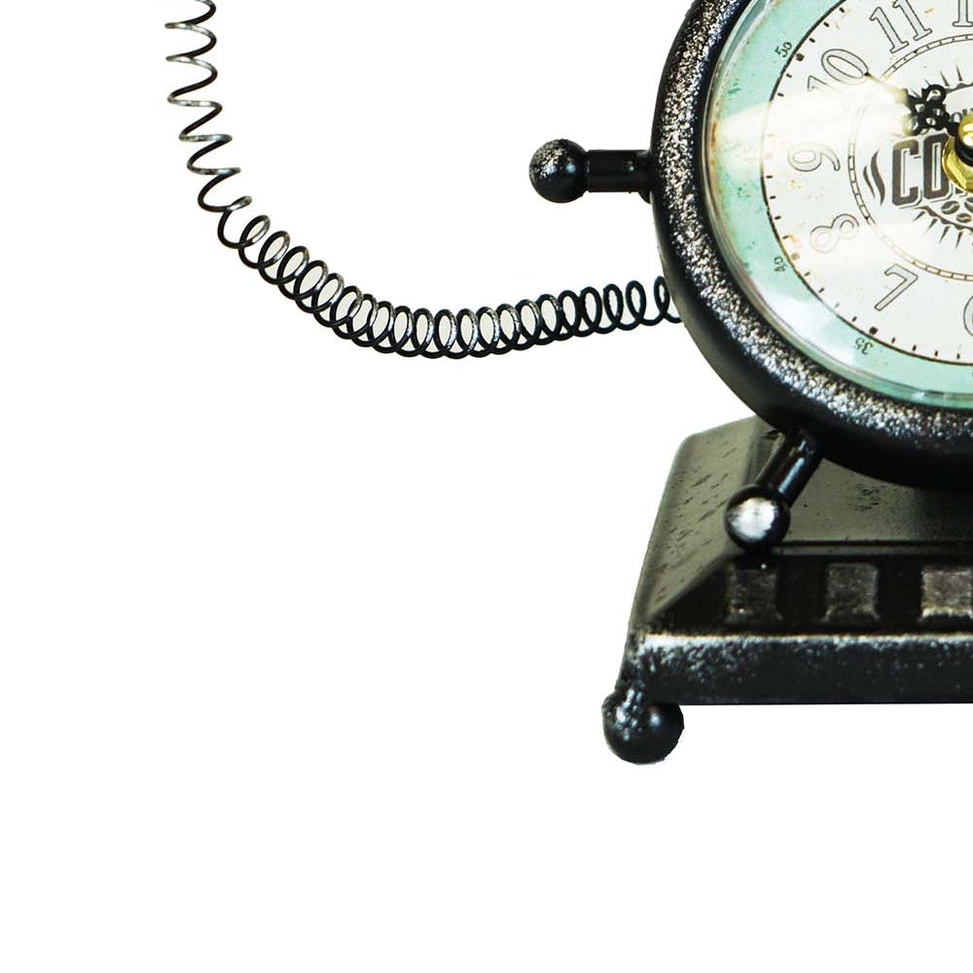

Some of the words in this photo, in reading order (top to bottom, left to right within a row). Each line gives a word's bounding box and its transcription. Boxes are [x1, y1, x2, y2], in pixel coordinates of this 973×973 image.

[774, 40, 793, 59] 50
[787, 142, 842, 173] 9
[809, 213, 860, 254] 8
[873, 263, 919, 312] 7
[855, 337, 874, 356] 35
